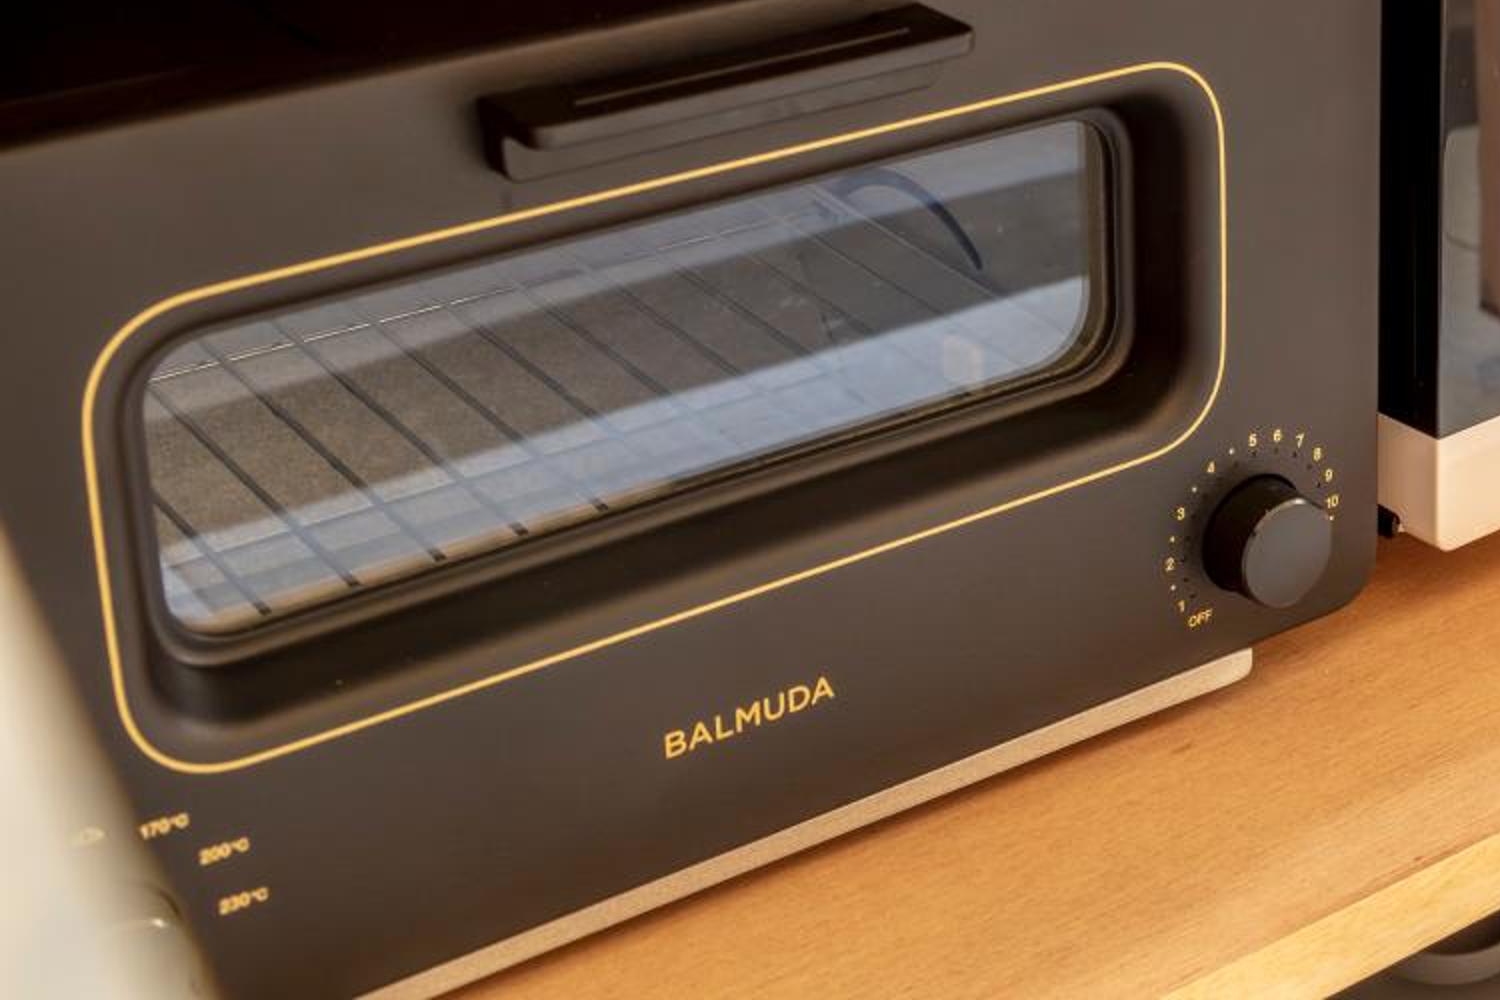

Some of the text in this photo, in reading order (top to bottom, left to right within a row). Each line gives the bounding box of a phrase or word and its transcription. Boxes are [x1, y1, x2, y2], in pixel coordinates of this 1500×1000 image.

[1249, 434, 1258, 447] 5
[1273, 428, 1282, 442] 6
[1296, 433, 1305, 447] 7
[1313, 448, 1322, 461] 8
[1207, 461, 1215, 473] 4
[1325, 469, 1334, 482] 9
[1327, 495, 1339, 508] 10
[1176, 507, 1185, 521] 3
[1165, 558, 1175, 571] 2
[1178, 600, 1185, 612] 1
[1187, 609, 1213, 627] OFF
[663, 675, 836, 760] BALMUDA
